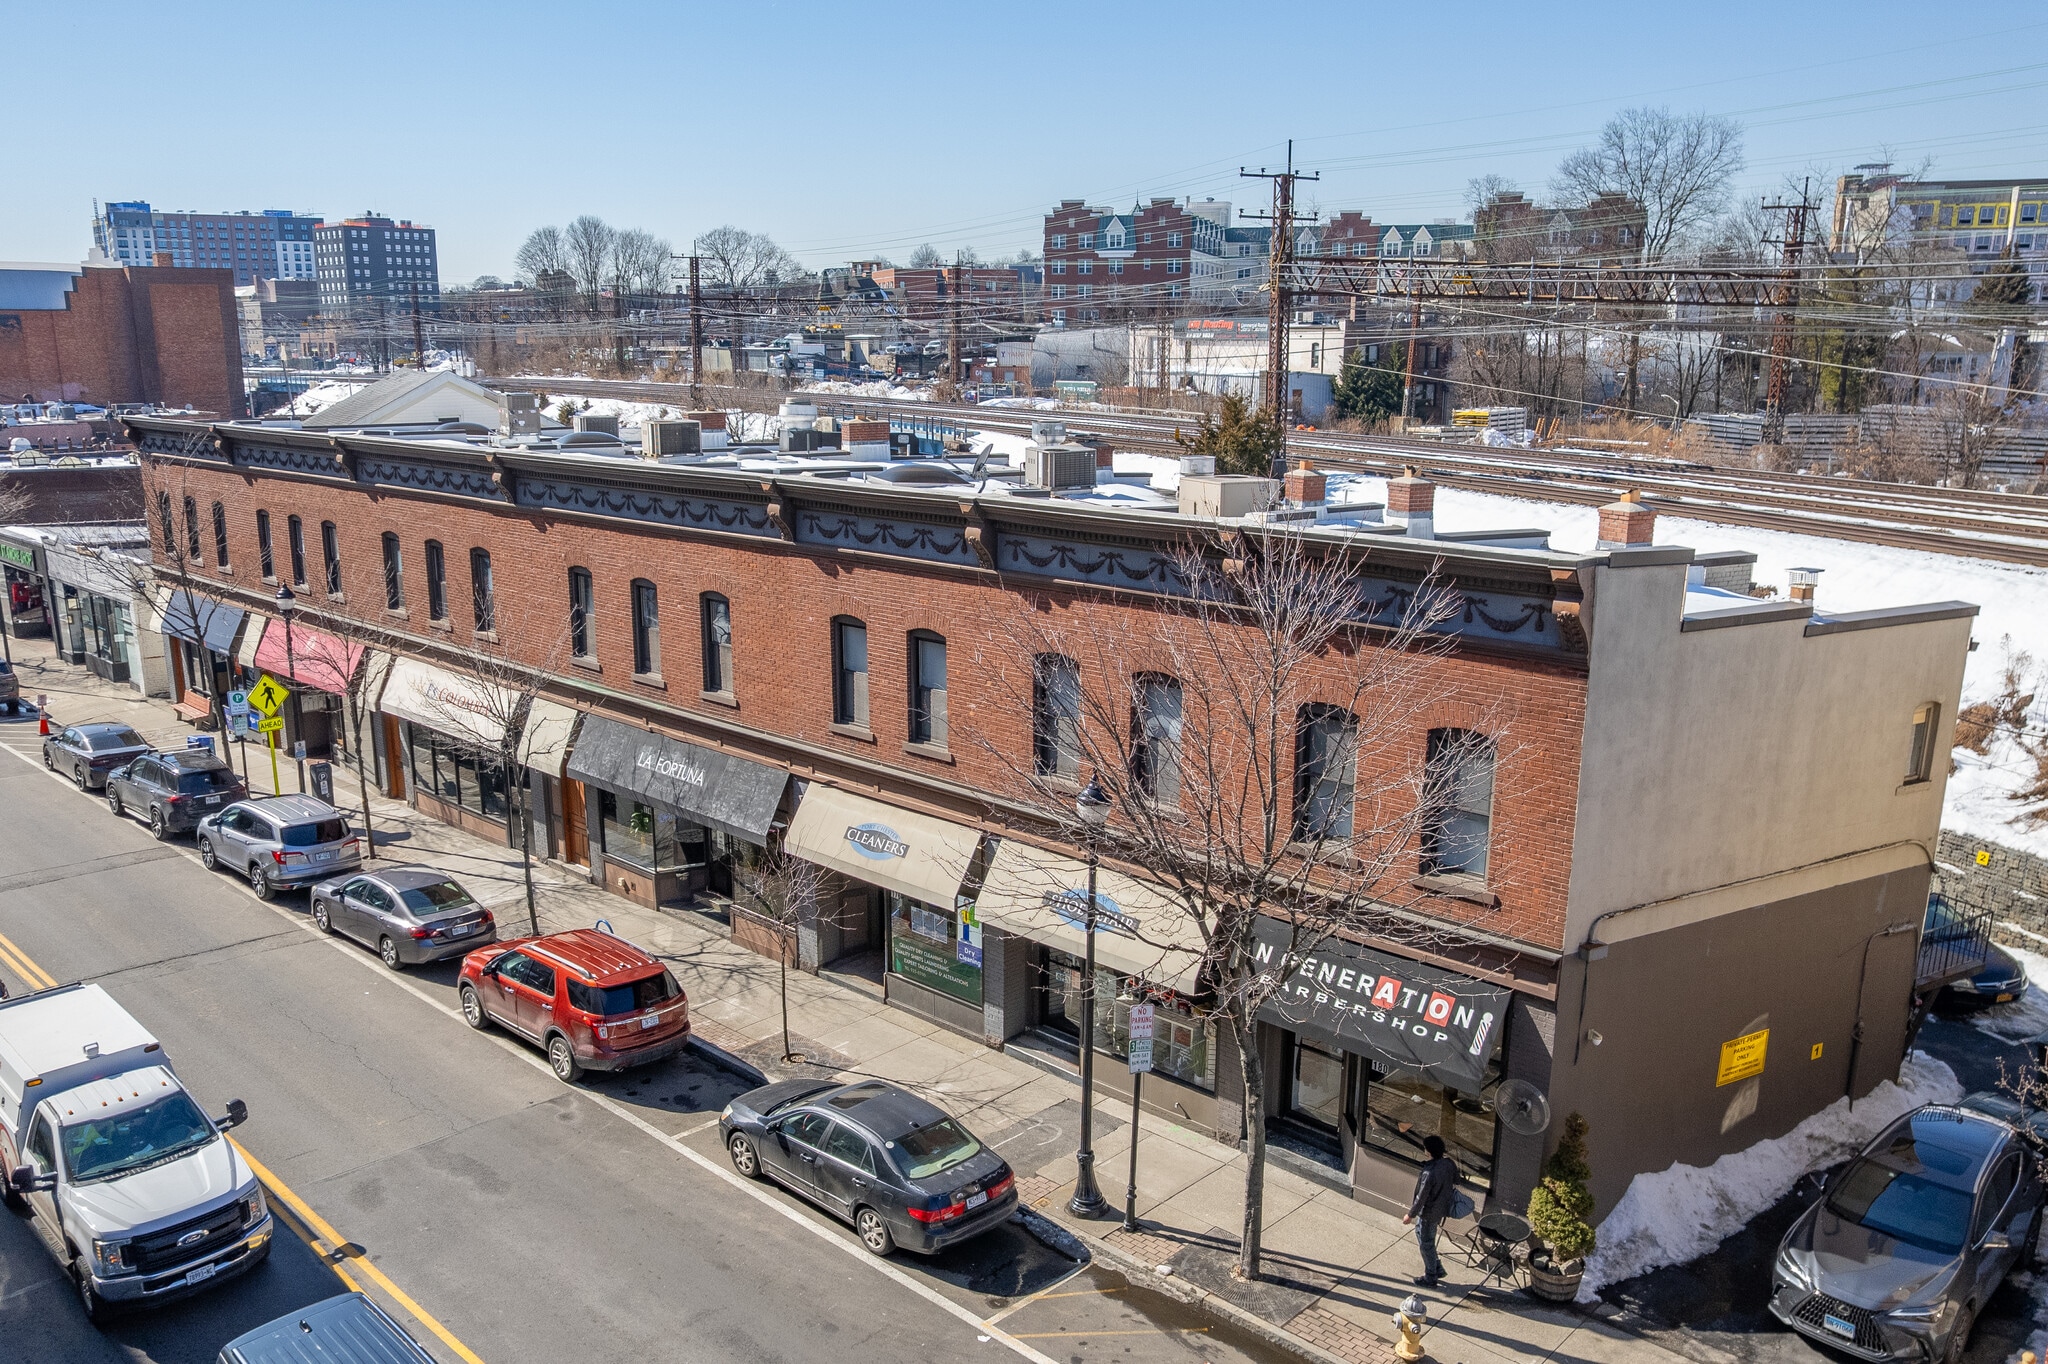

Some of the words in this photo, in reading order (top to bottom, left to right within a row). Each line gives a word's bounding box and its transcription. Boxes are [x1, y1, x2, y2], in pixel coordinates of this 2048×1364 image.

[260, 720, 282, 730] AHEAD
[638, 751, 652, 770] LA
[655, 758, 705, 787] FORTUNA
[847, 828, 907, 856] CLEANERS
[1092, 908, 1134, 931] EPAIR
[964, 947, 976, 957] Dry
[959, 954, 982, 968] Cleaning
[1281, 952, 1475, 1030] GENERATION
[1260, 974, 1449, 1043] BARBERSHOP
[1131, 1015, 1152, 1023] PARKING
[1736, 1053, 1750, 1062] ONLY
[1373, 1061, 1388, 1074] 180
